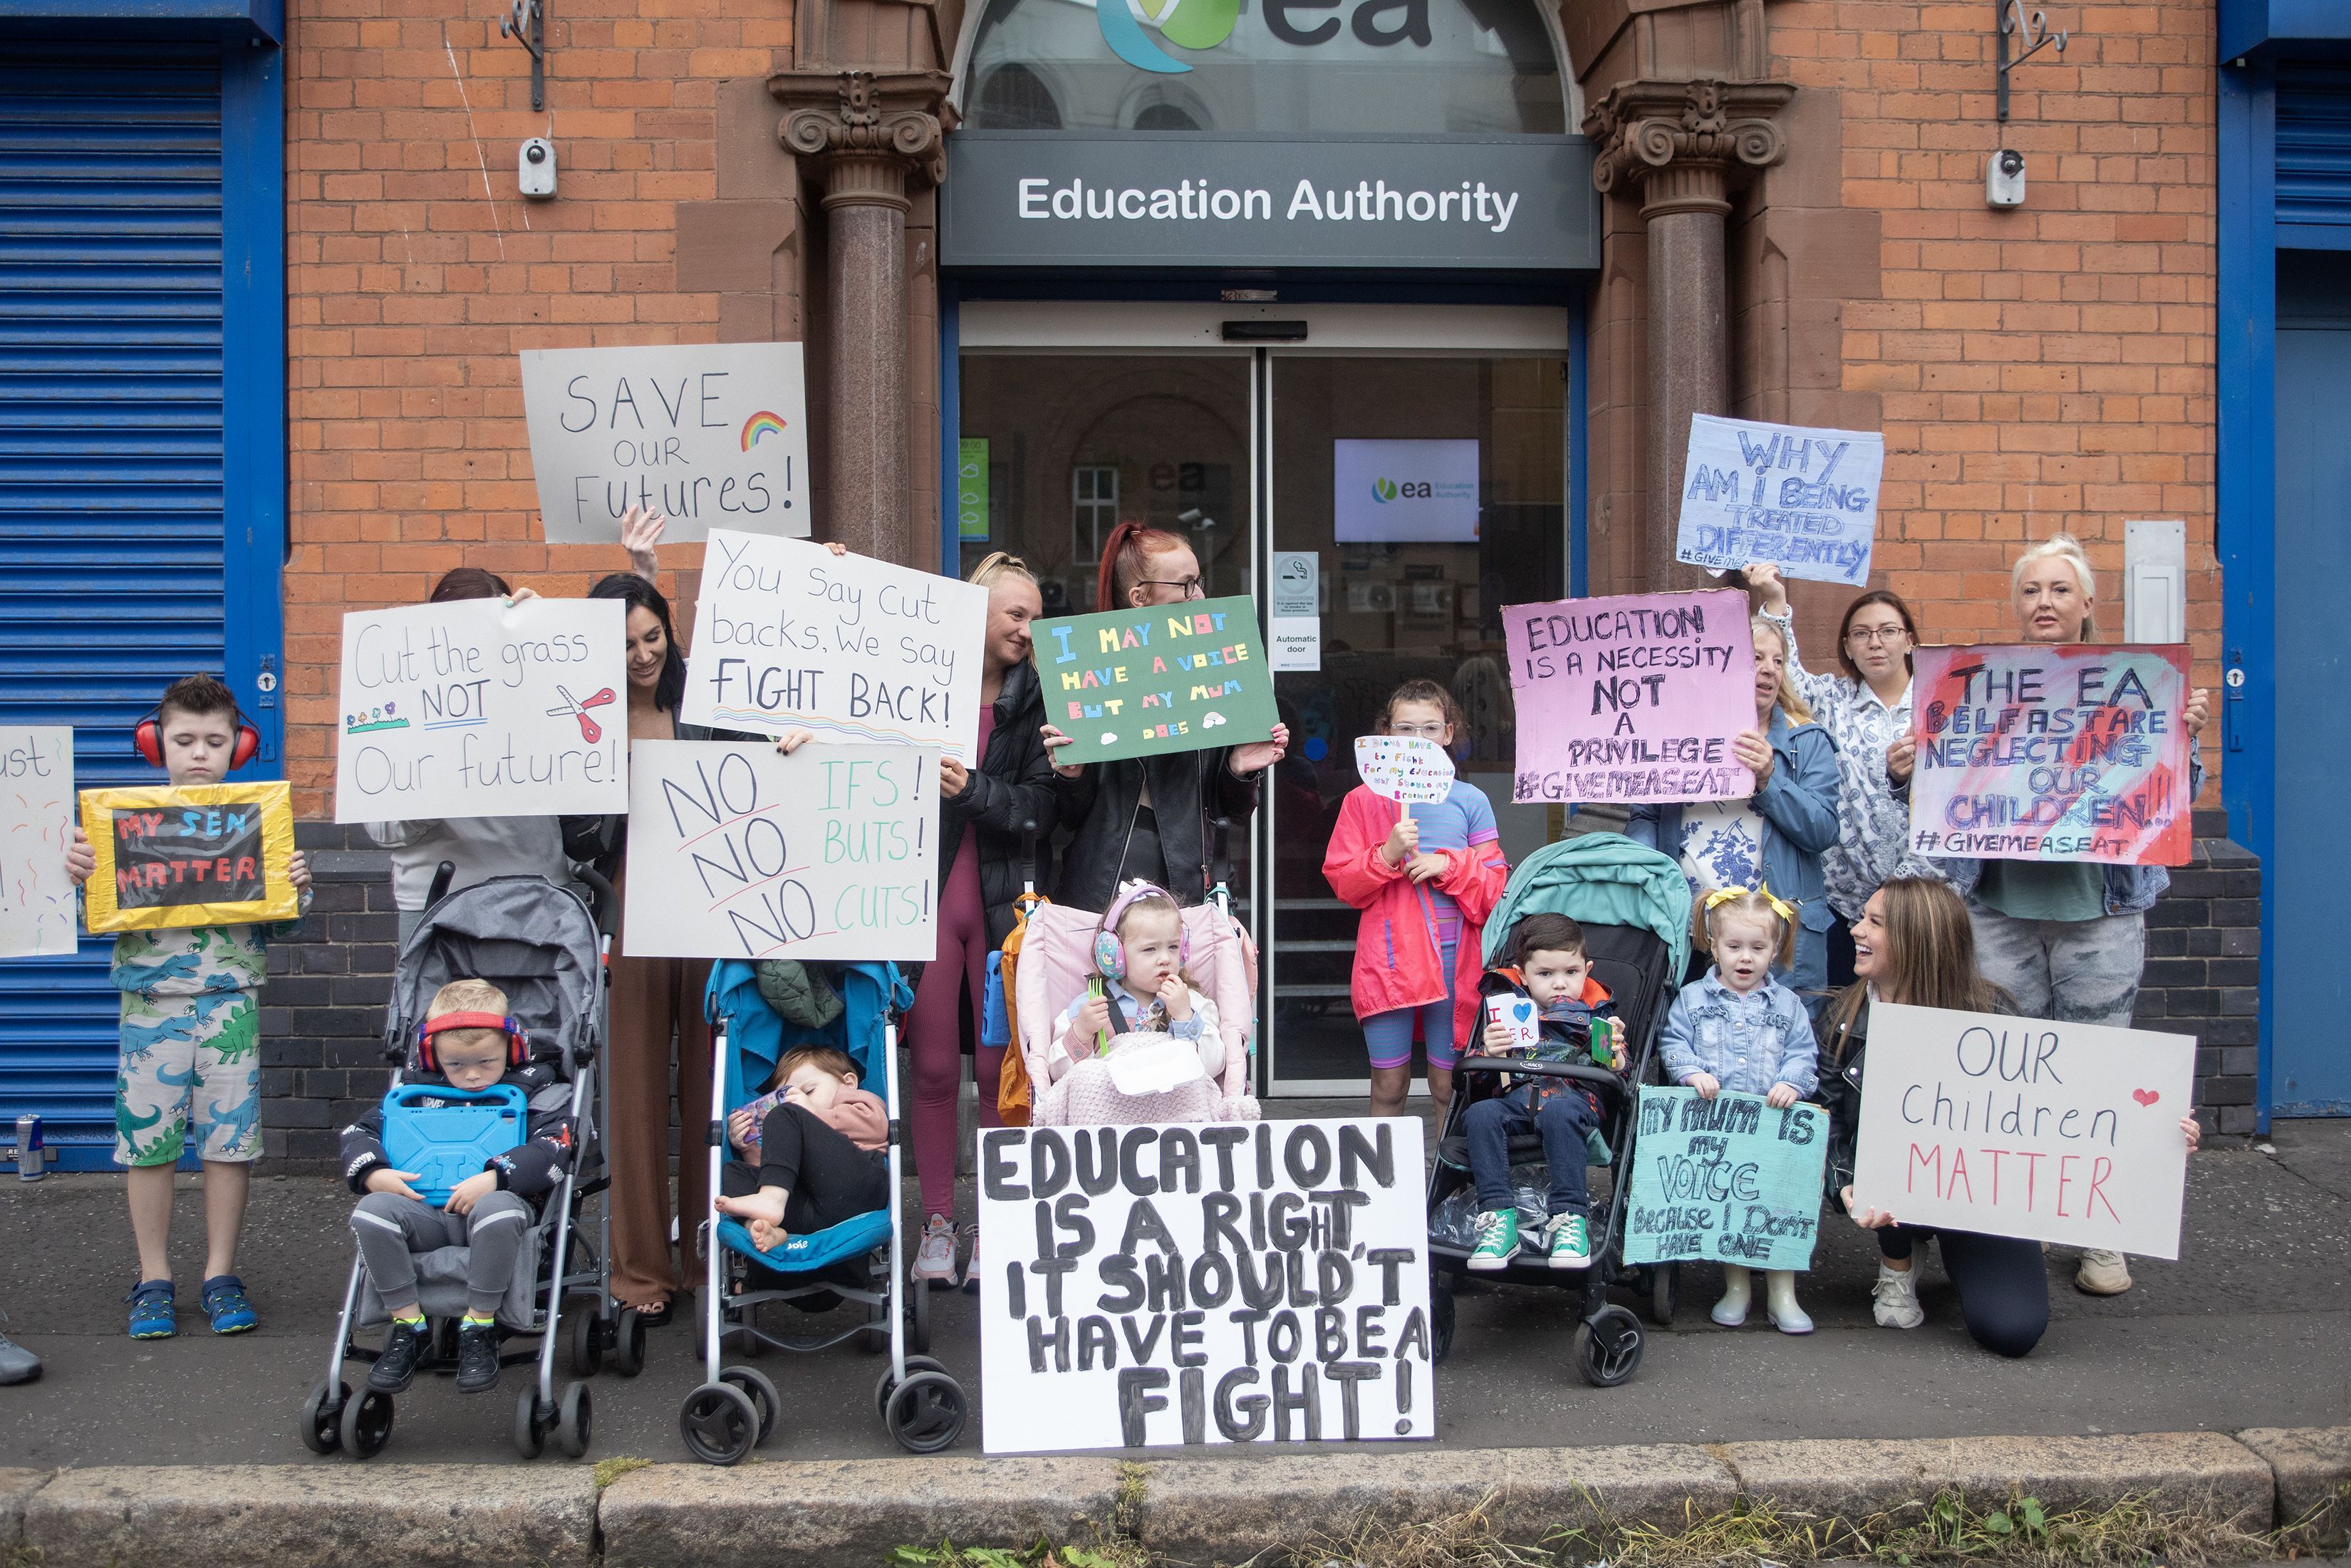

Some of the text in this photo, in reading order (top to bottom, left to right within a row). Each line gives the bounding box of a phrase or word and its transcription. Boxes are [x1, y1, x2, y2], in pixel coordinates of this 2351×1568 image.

[1018, 178, 1519, 233] Education Authority
[560, 372, 730, 433] SAVE
[614, 437, 690, 467] OUR
[1737, 430, 1850, 484] WHY
[575, 455, 792, 524] Futures!
[1401, 482, 1432, 498] ea
[1687, 464, 1739, 502] AM
[1779, 477, 1871, 513] BEING
[1724, 504, 1845, 536] TREATED
[717, 539, 782, 595] You
[1693, 524, 1871, 579] DIFFERENTLY
[712, 603, 828, 654] backs,
[1050, 613, 1227, 665] I MAY NOT
[1526, 605, 1706, 653] EDUCATION
[355, 624, 589, 688] Cut the grass
[1061, 643, 1250, 690] HAVE A VOICE
[1526, 655, 1557, 680] IS
[1567, 652, 1583, 676] A
[422, 679, 492, 720] NOT
[710, 658, 951, 729] FIGHT BACK!
[1067, 680, 1242, 720] BUT MY MUM
[1591, 674, 1666, 716] NOT
[1948, 663, 2154, 710] THE EA
[1143, 720, 1189, 740] DOES
[1614, 712, 1636, 736] A
[1926, 700, 2168, 735] BELFAST ARE
[355, 732, 617, 795] Our future!
[1356, 738, 1367, 749] I
[1408, 740, 1432, 750] HAVE
[1567, 737, 1726, 768] PRIVILEGE
[662, 753, 757, 838] NO
[2028, 766, 2109, 795] OUR
[116, 811, 246, 841] MY SEN
[116, 856, 256, 893] MATTER
[692, 816, 924, 898] NO BUTS!
[728, 878, 929, 957] NO CUTS!
[1489, 1007, 1501, 1024] I
[1957, 1026, 2063, 1085] OUR
[1680, 1098, 1763, 1135] MUM
[1777, 1108, 1815, 1146] IS
[983, 1123, 1397, 1201] EDUCATION
[1907, 1143, 2121, 1224] MATTER
[1035, 1190, 1372, 1260] IS A RIGHT
[1722, 1202, 1732, 1231] I
[1655, 1232, 1775, 1261] HAVE ONE
[1006, 1257, 1079, 1322] IT
[1026, 1304, 1430, 1374] HAVE TO BE A
[1118, 1358, 1413, 1447] FIGHT!
